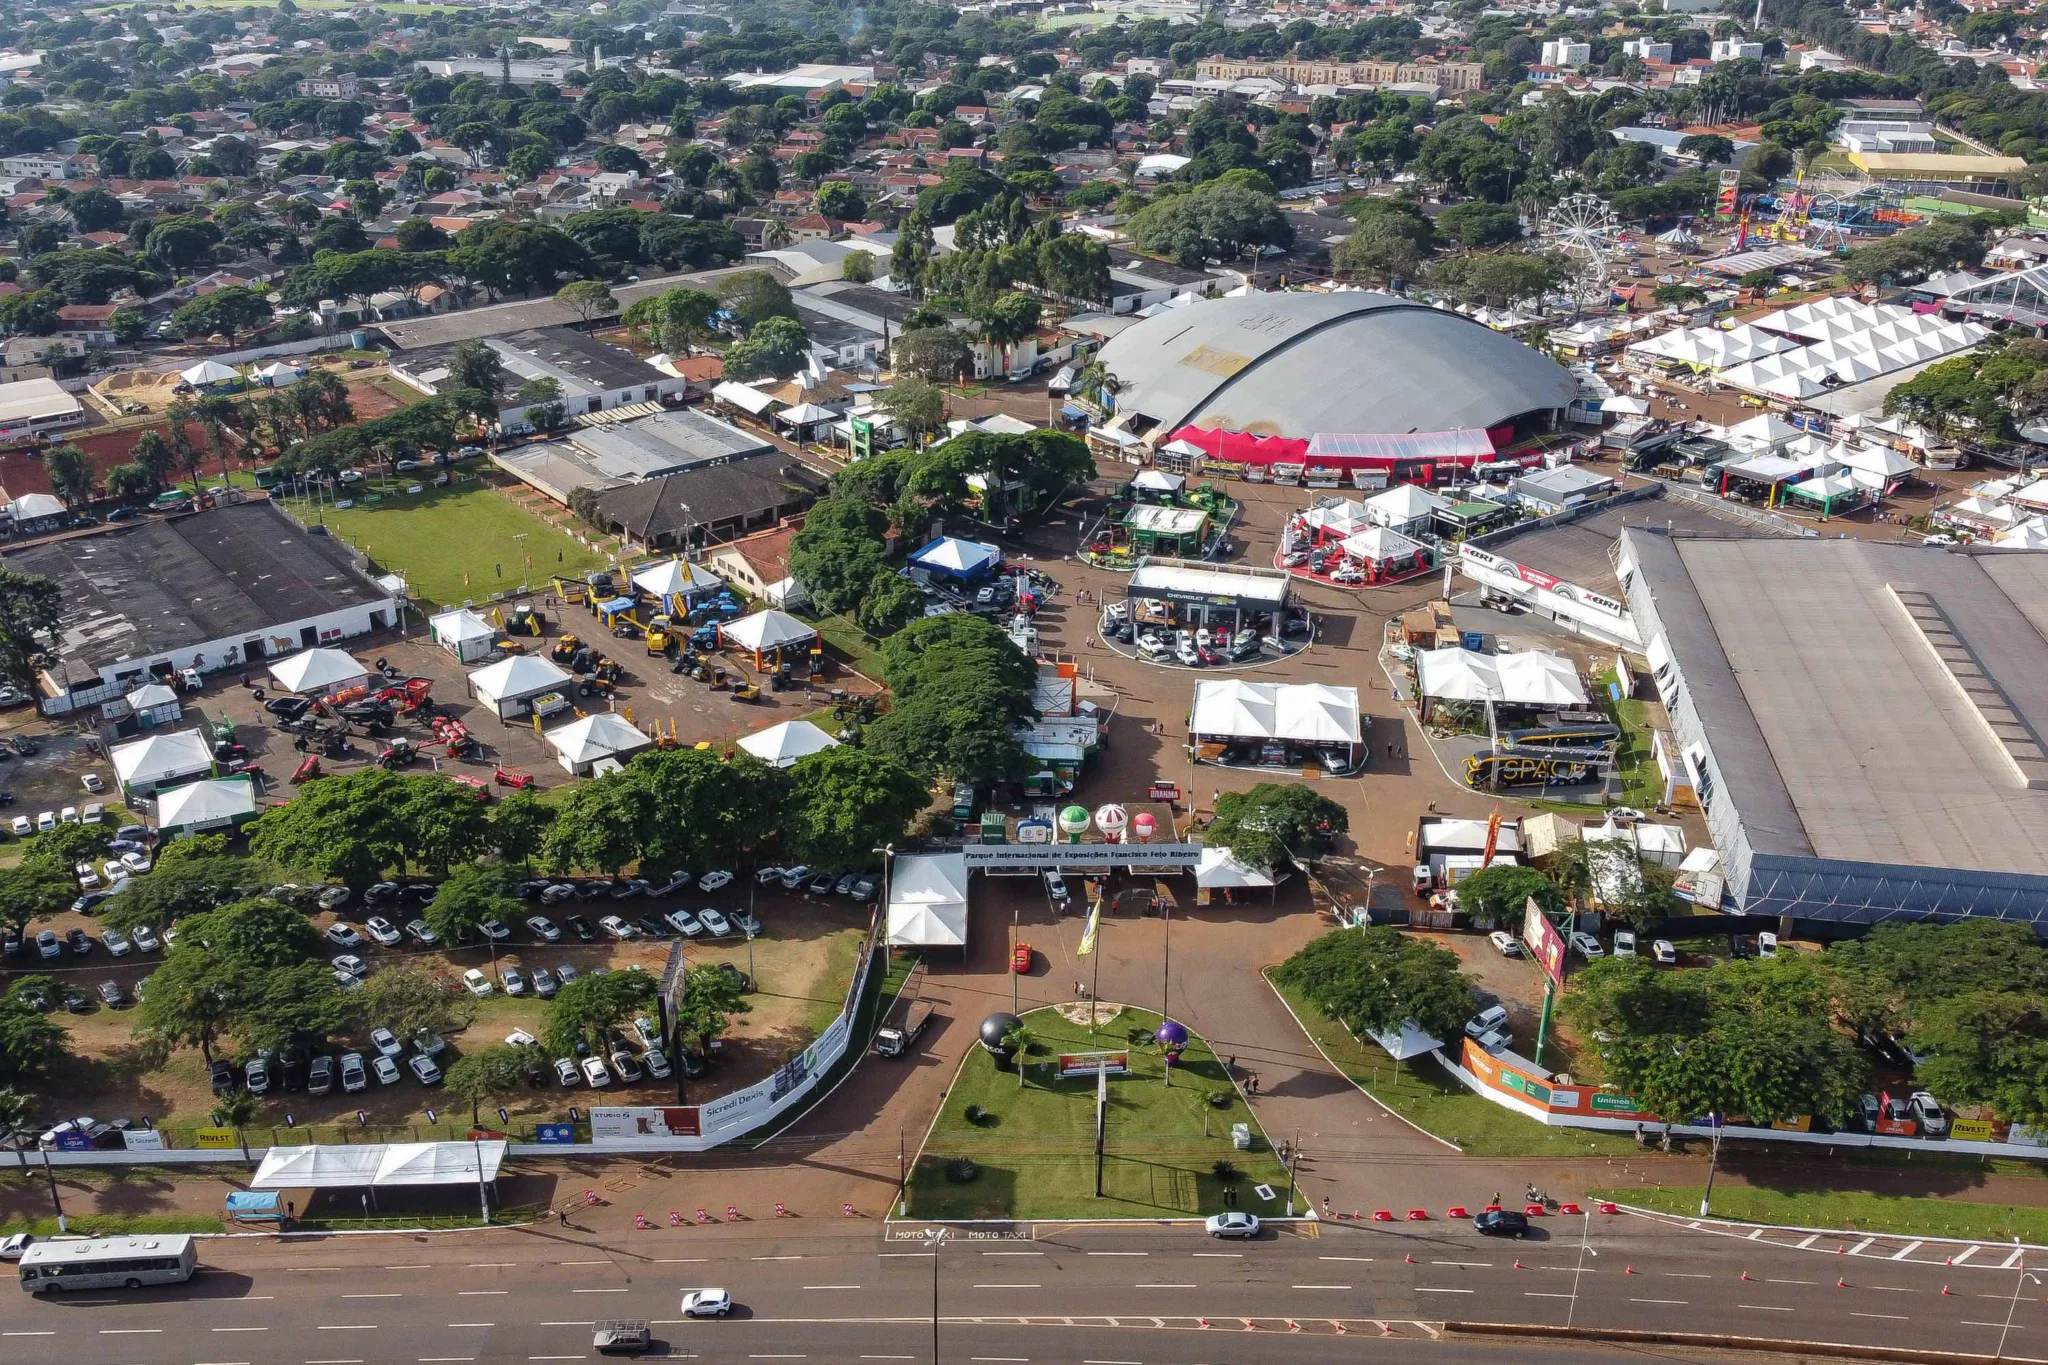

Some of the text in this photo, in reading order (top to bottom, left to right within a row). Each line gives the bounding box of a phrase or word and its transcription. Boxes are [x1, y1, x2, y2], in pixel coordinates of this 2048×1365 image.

[1166, 592, 1204, 601] CHEVROLET
[1150, 790, 1179, 799] BRAHMA
[965, 851, 994, 860] Parque
[996, 851, 1049, 859] Internacional
[1052, 851, 1062, 859] de
[1064, 851, 1109, 860] Exposições
[1111, 851, 1148, 859] Francisco
[1170, 850, 1199, 859] Ribeiro
[706, 1098, 738, 1118] Sicredi
[738, 1089, 764, 1105] Dexis
[895, 1231, 924, 1239] MOTO
[968, 1231, 1026, 1239] MOTO TAXI
